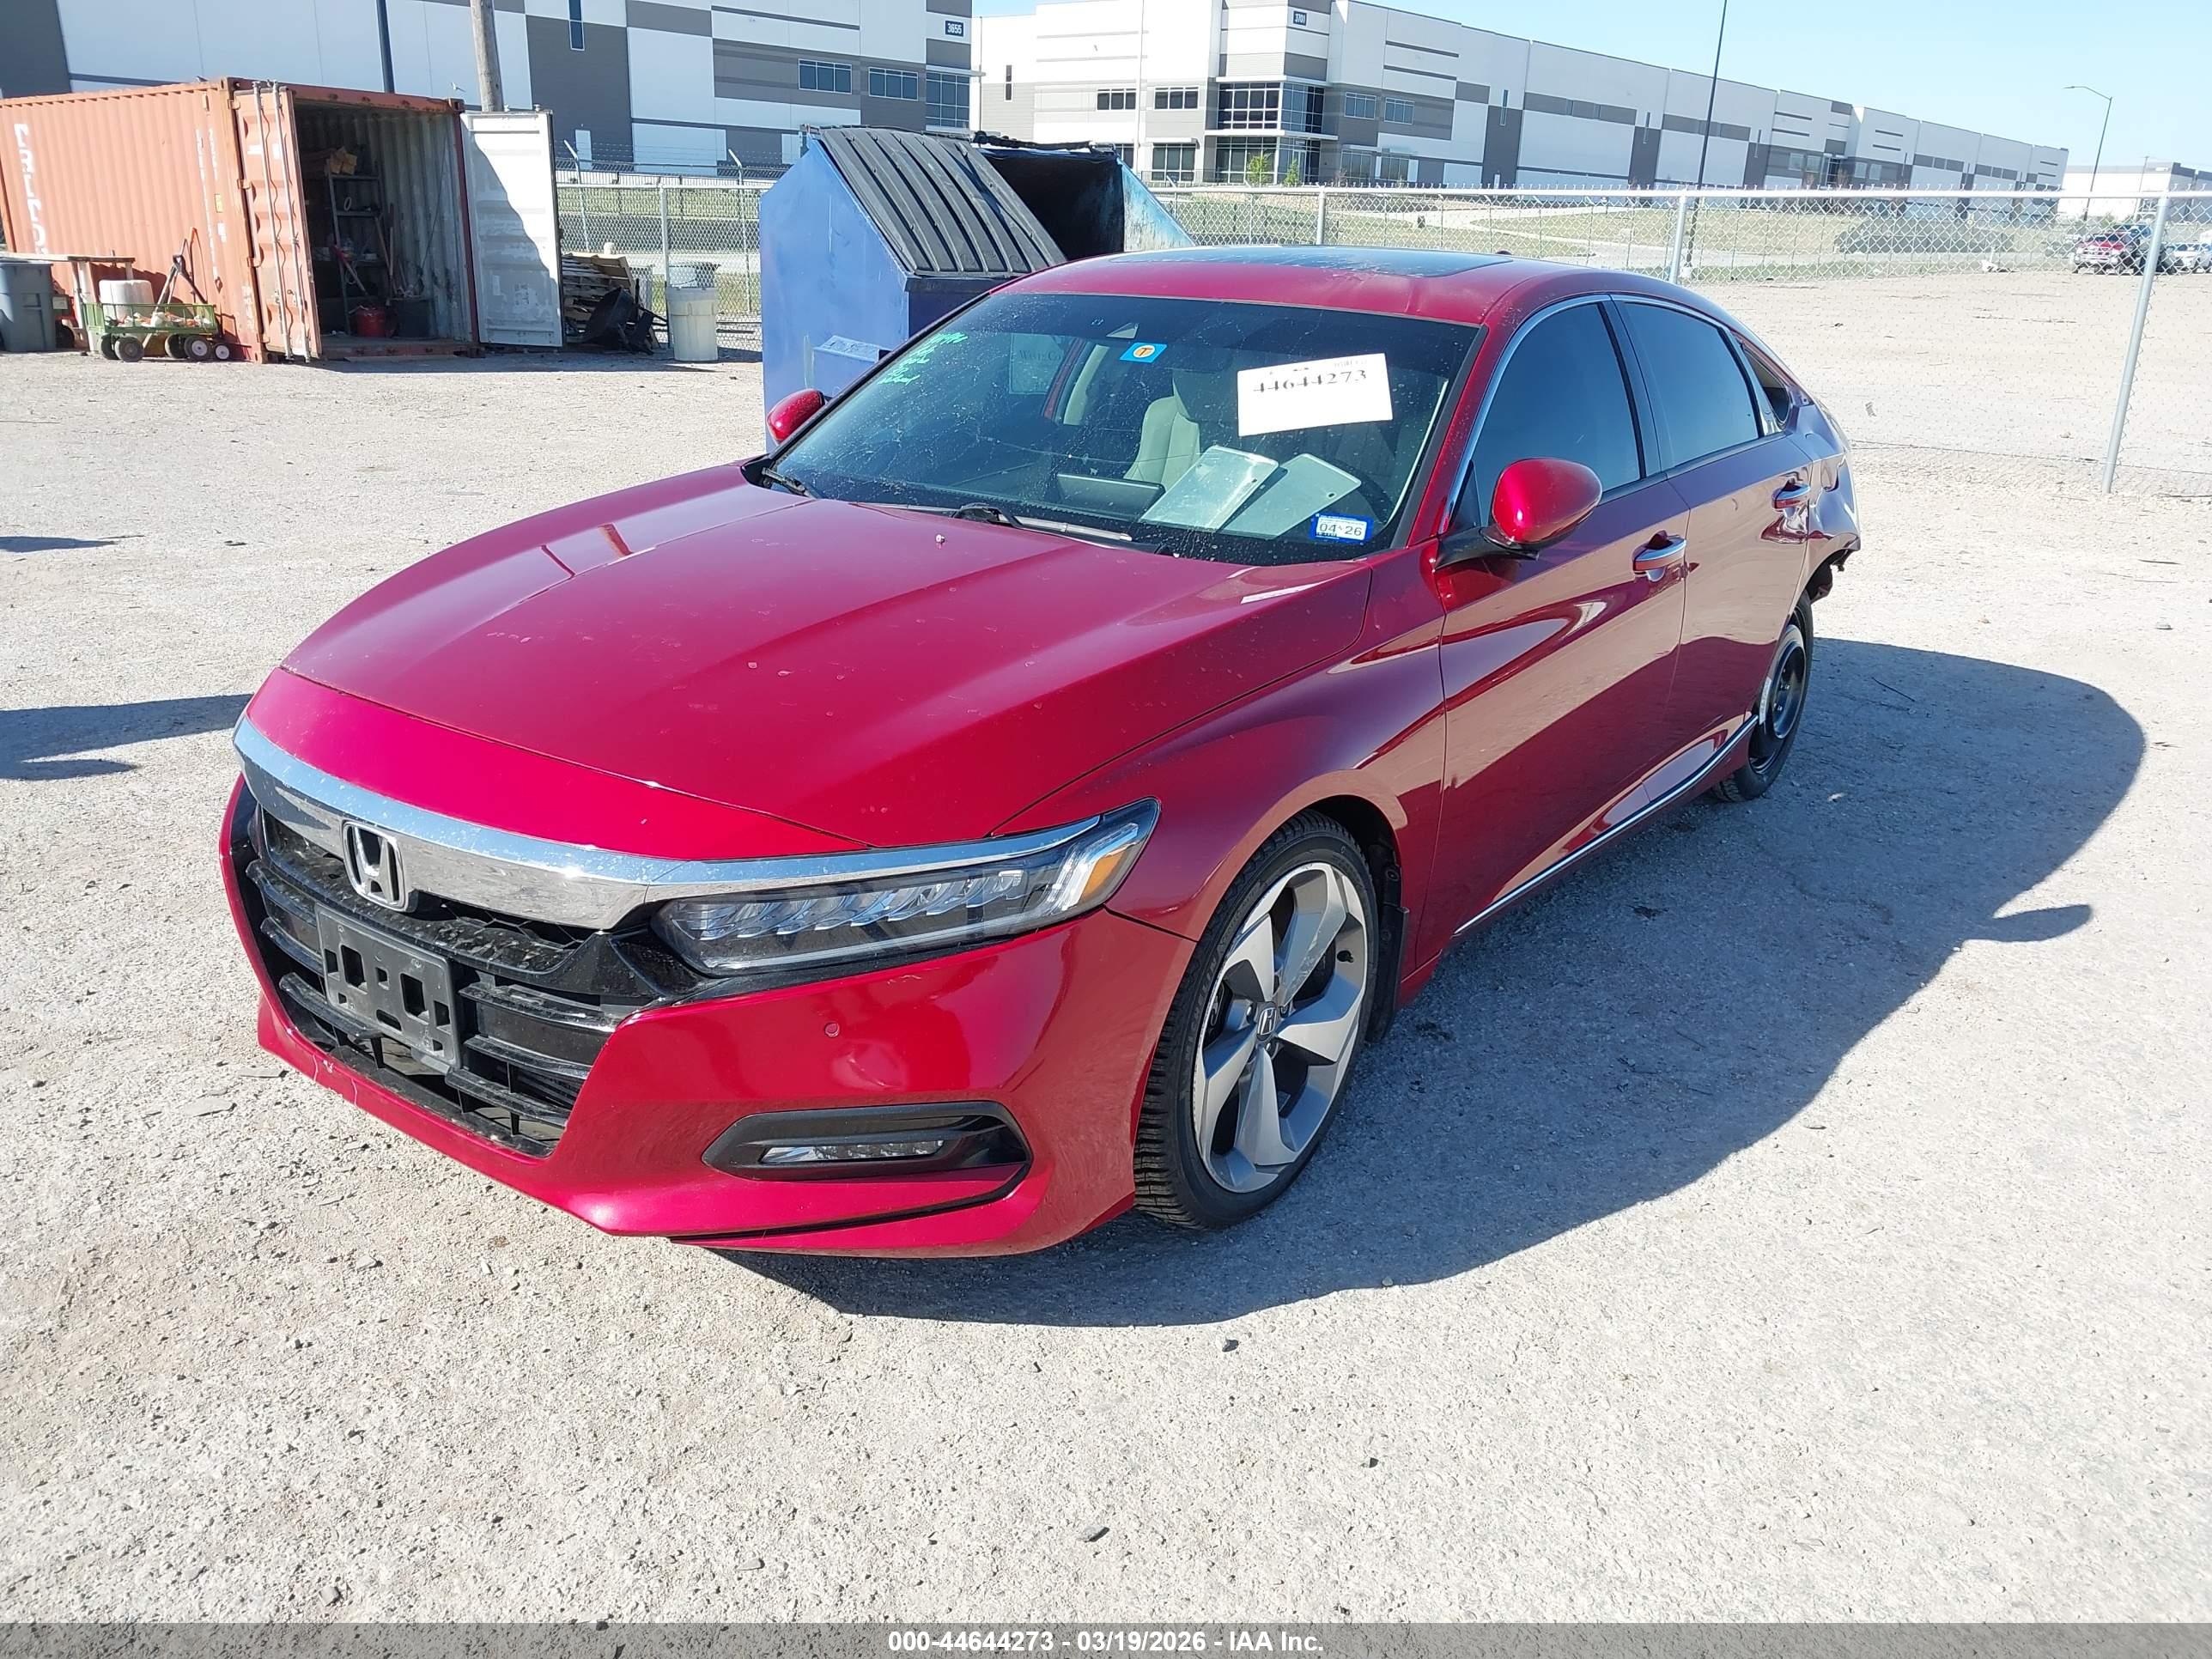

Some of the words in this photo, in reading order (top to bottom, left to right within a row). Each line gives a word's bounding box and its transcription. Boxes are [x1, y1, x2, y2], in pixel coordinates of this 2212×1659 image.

[947, 22, 963, 34] 3655
[1253, 369, 1367, 393] 44644273
[1319, 523, 1337, 533] 04
[1344, 526, 1363, 537] 26
